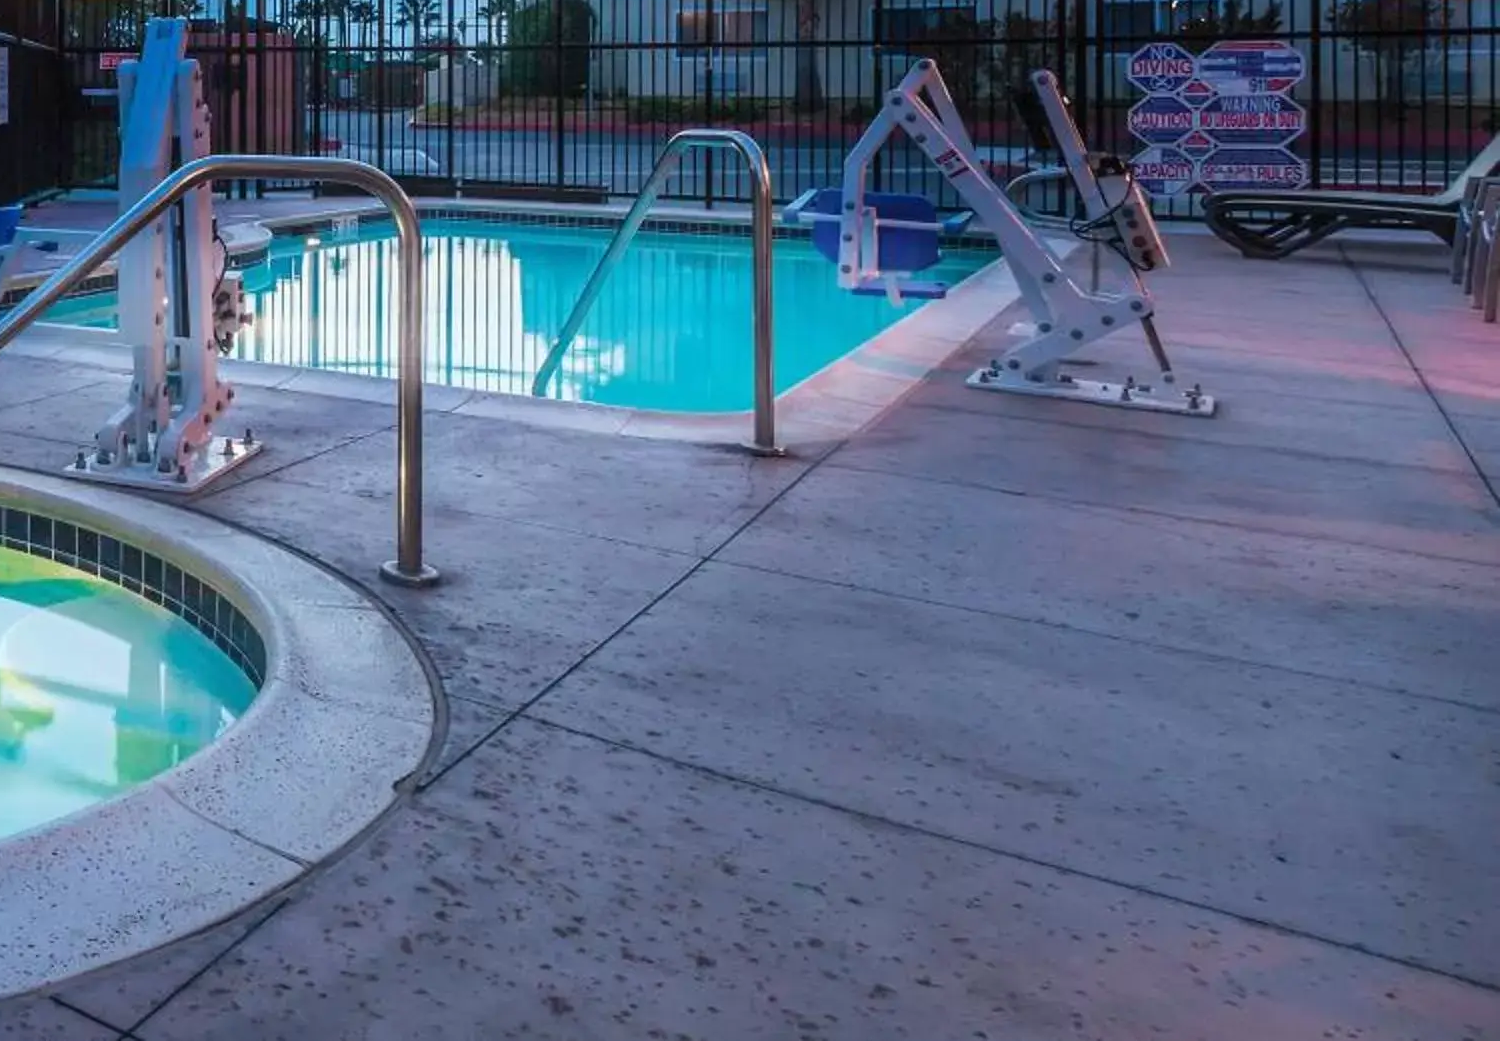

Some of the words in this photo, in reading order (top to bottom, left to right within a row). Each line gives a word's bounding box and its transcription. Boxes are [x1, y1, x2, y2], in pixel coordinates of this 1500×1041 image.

[1148, 46, 1176, 60] NO
[1131, 60, 1193, 76] DIVING
[1219, 95, 1281, 112] WARNING
[1131, 111, 1192, 129] CAUTION
[1132, 164, 1193, 180] CAPACITY
[1256, 165, 1303, 181] RULES
